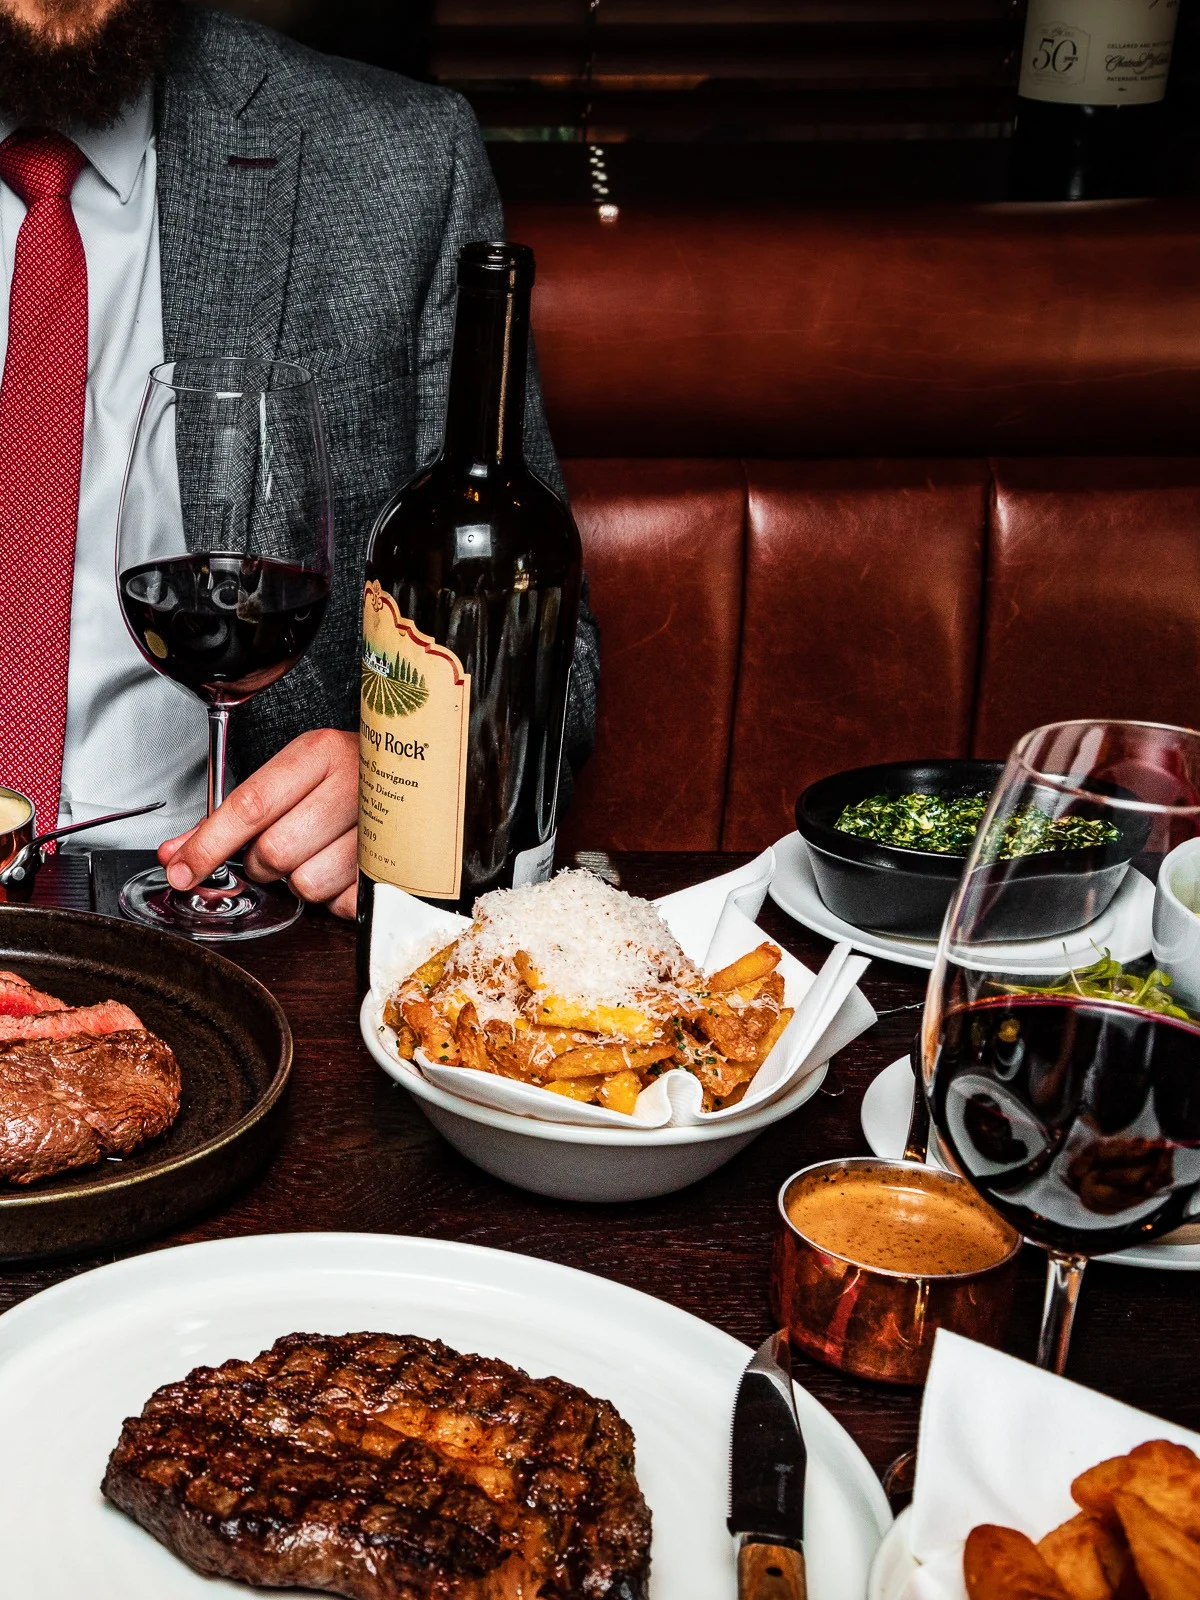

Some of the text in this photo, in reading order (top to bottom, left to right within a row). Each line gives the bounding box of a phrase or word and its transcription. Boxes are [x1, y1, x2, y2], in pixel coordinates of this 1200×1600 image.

[1032, 37, 1078, 73] 50
[371, 760, 419, 788] Sauvignon
[376, 783, 405, 802] District
[371, 797, 389, 816] Valley
[363, 825, 377, 842] 2019
[369, 849, 396, 867] GROWN
